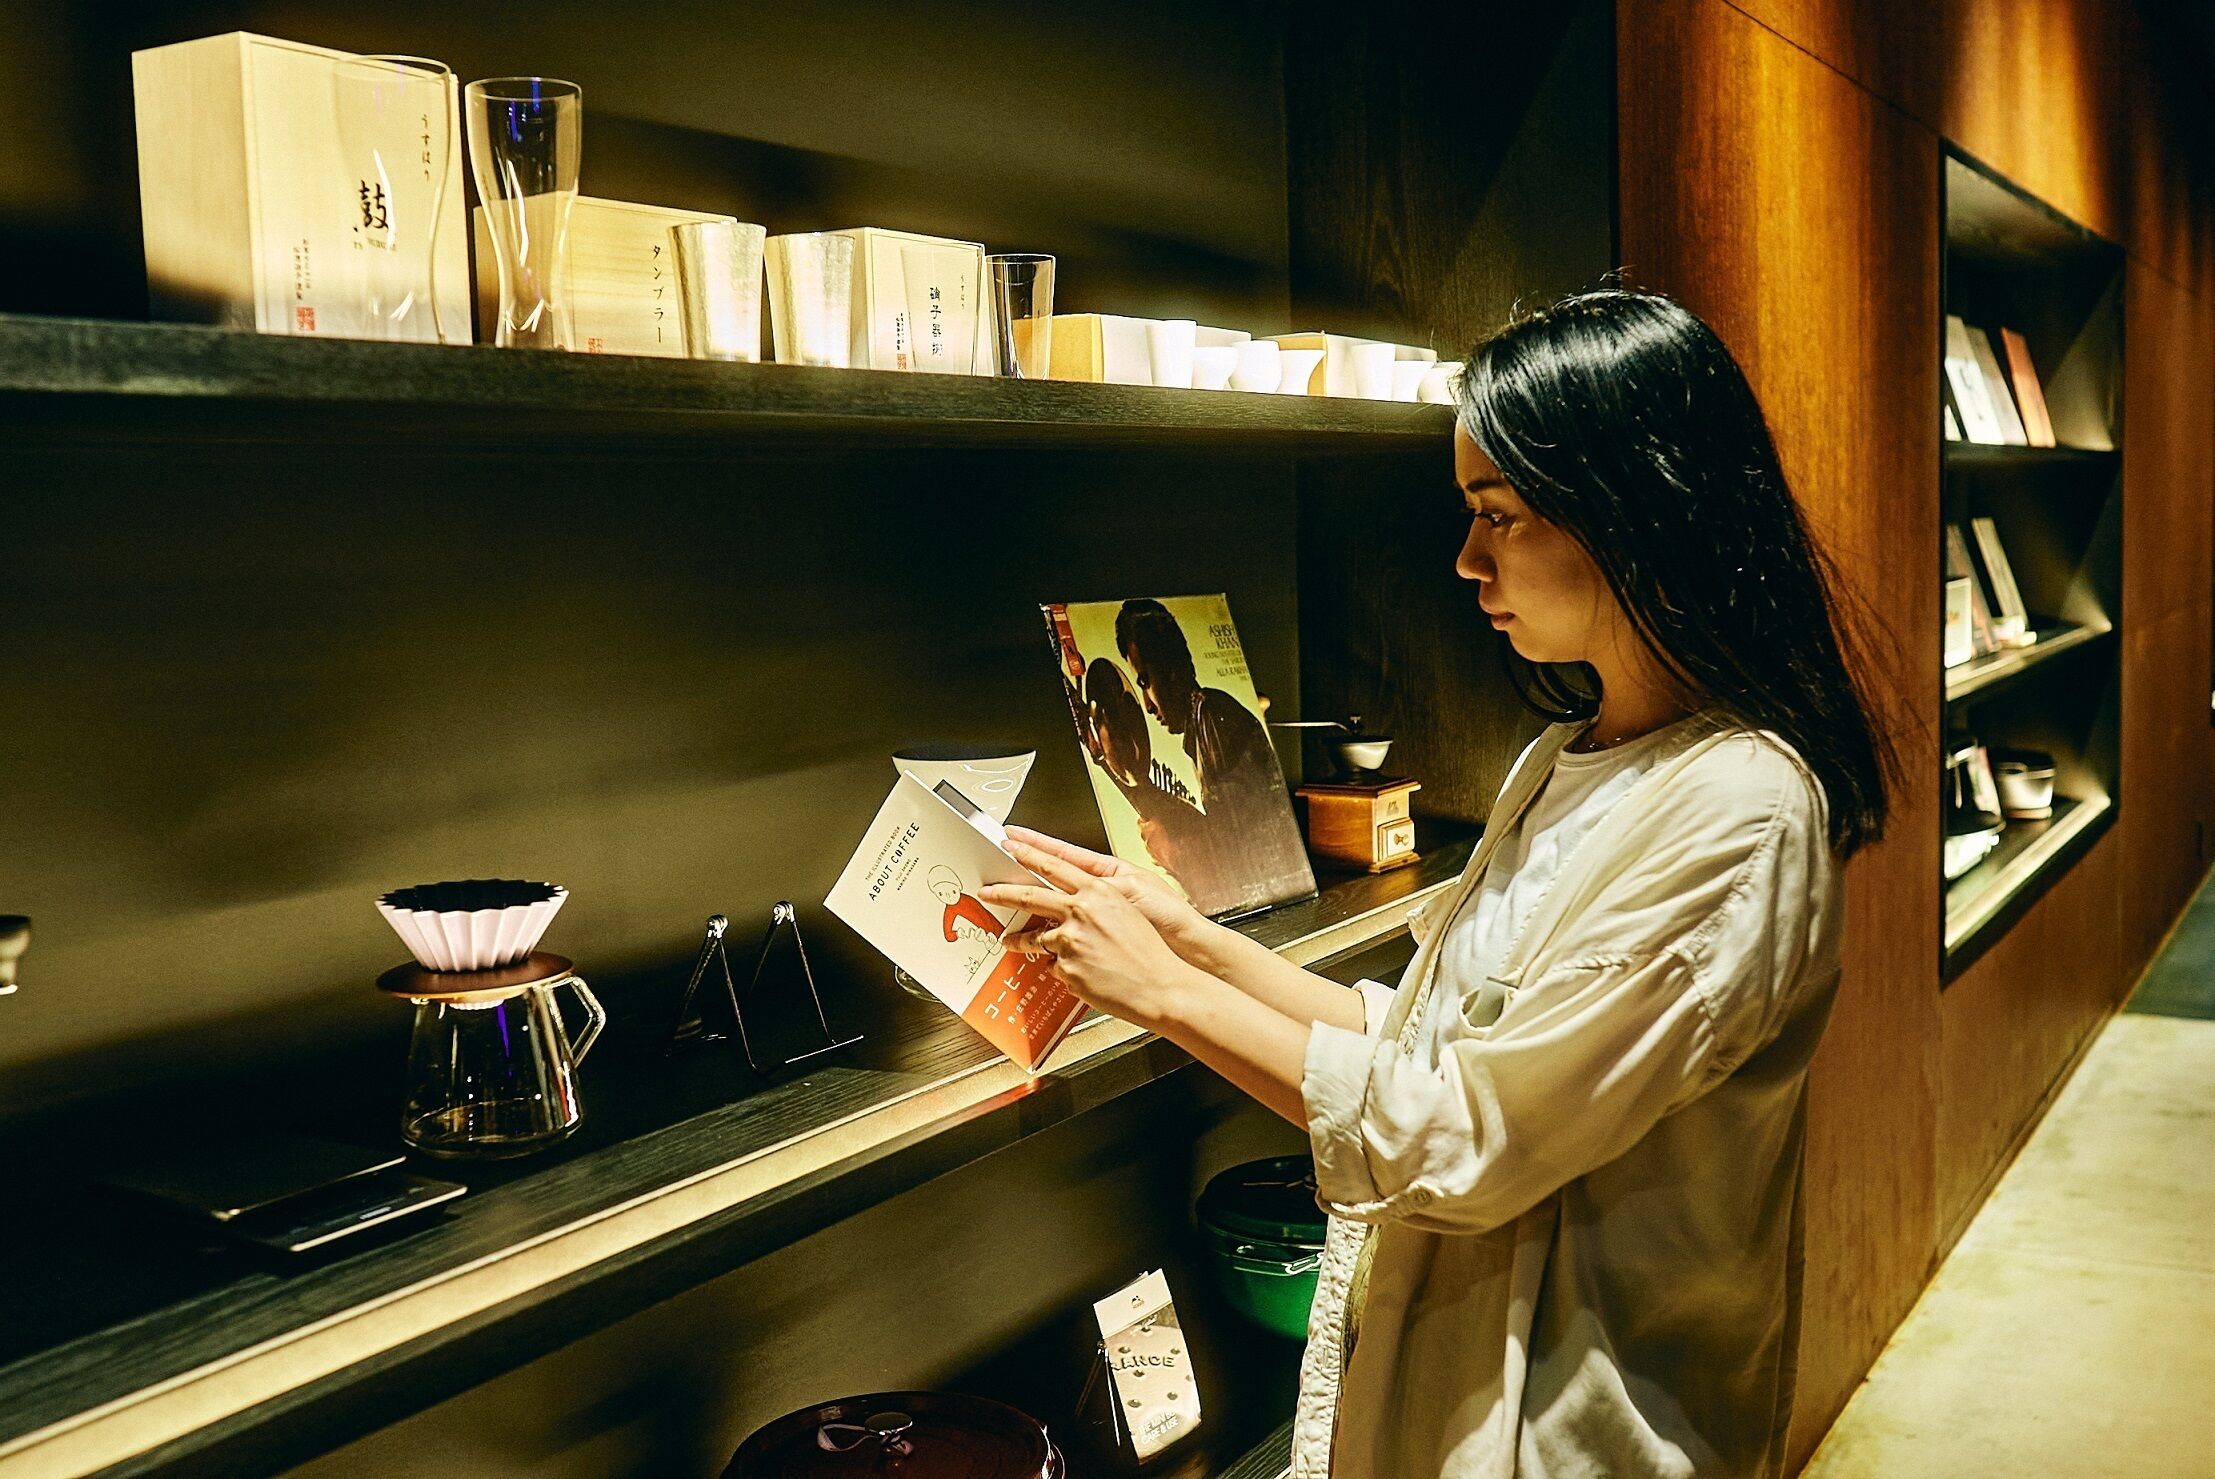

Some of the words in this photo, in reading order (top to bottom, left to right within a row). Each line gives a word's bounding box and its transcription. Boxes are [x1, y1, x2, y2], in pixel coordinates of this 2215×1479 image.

[653, 245, 664, 343] タンブラー
[868, 864, 893, 901] ABOUT
[890, 822, 920, 864] COFFEE
